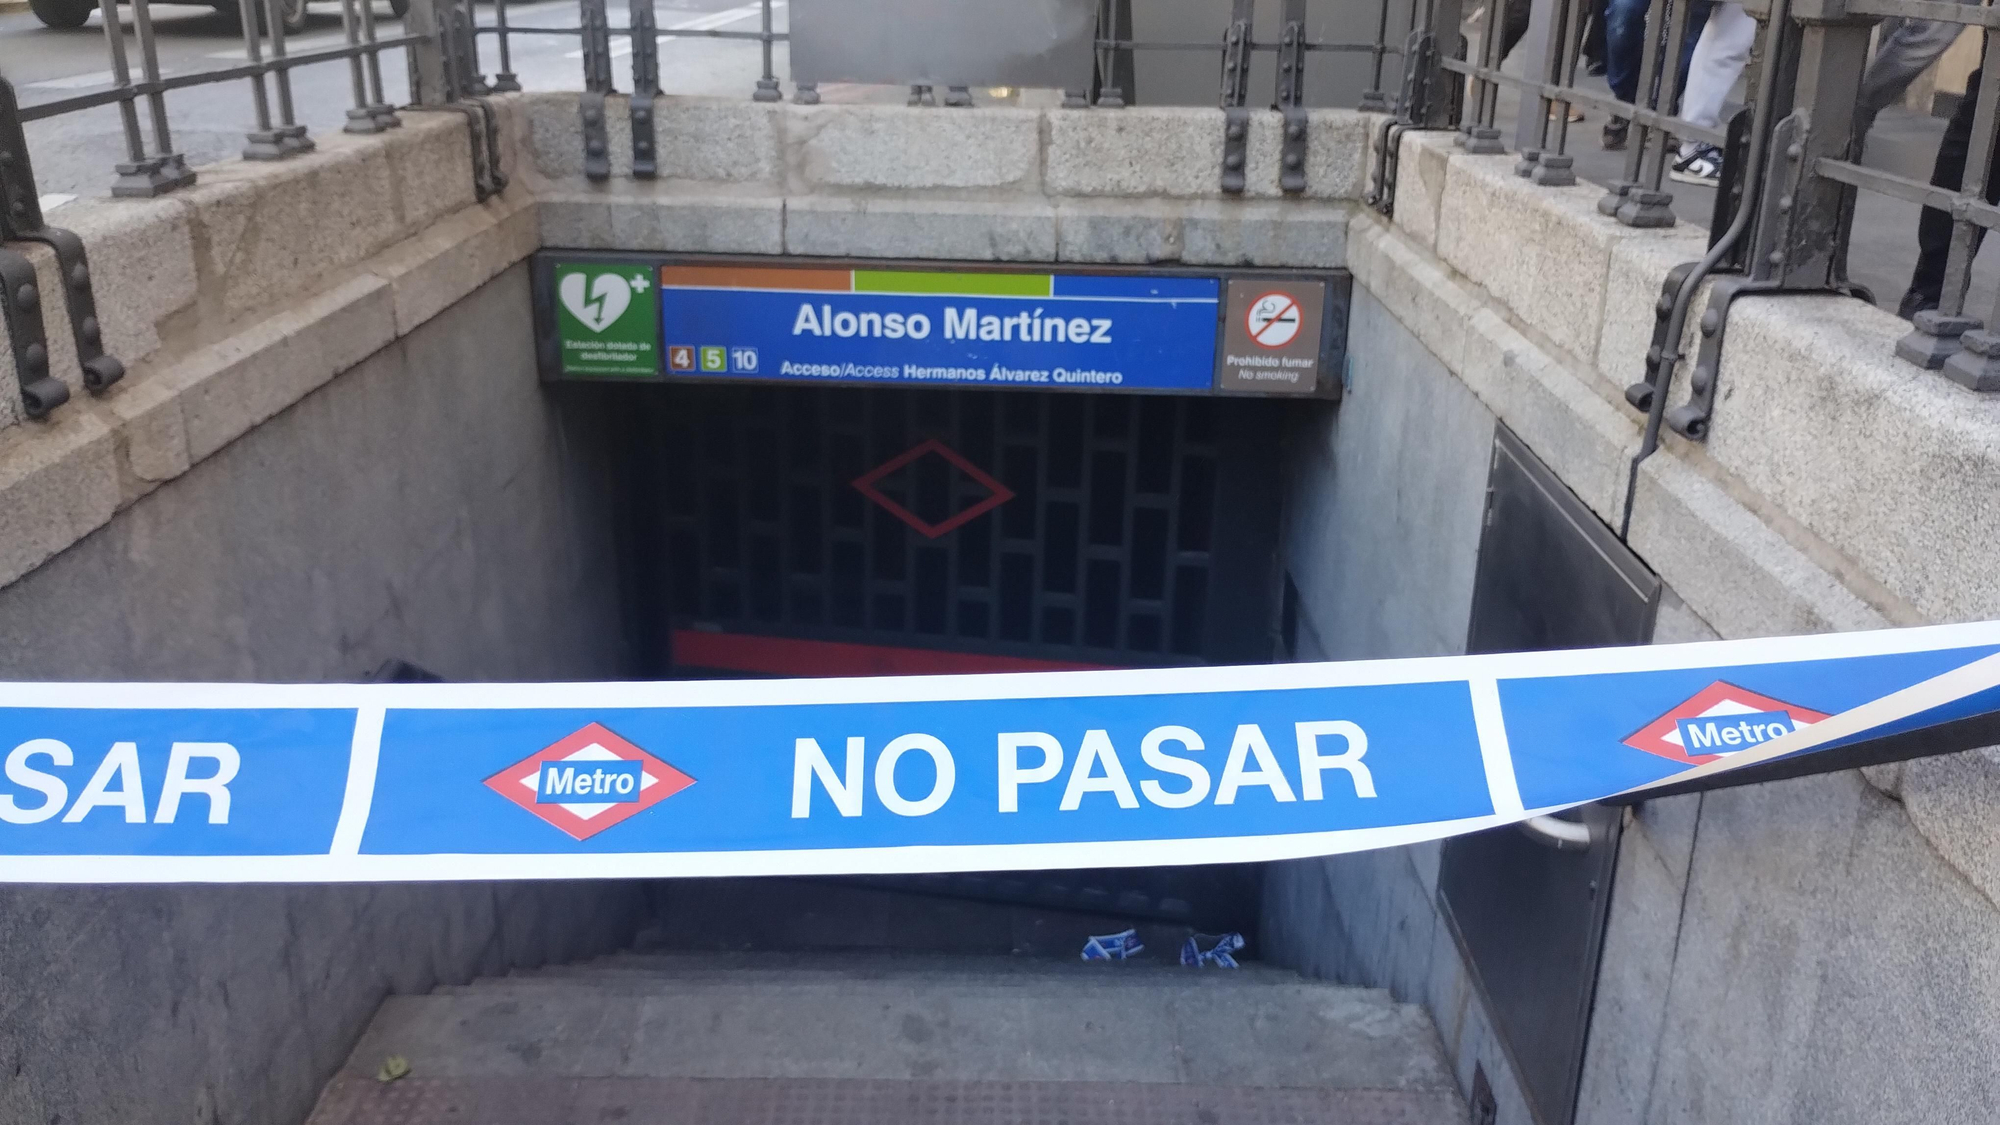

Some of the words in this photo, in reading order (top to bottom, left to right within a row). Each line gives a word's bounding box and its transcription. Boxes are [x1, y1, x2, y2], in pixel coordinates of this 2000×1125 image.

[793, 303, 932, 340] Alonso
[944, 307, 1113, 344] Martínez
[673, 348, 691, 369] 4
[705, 348, 722, 369] 5
[733, 349, 758, 370] 10
[781, 360, 899, 379] Acceso/Access
[903, 364, 986, 381] Hermanos
[989, 363, 1050, 383] Álvarez
[1052, 367, 1123, 385] Quintero
[1226, 354, 1279, 367] Prohibido
[1281, 356, 1314, 368] fumar
[1238, 369, 1254, 380] No
[1255, 370, 1299, 383] smoking
[1688, 721, 1788, 748] Metro
[0, 738, 241, 825] SAR
[545, 767, 635, 796] Metro
[791, 732, 956, 819] NO
[997, 720, 1378, 813] PASAR
